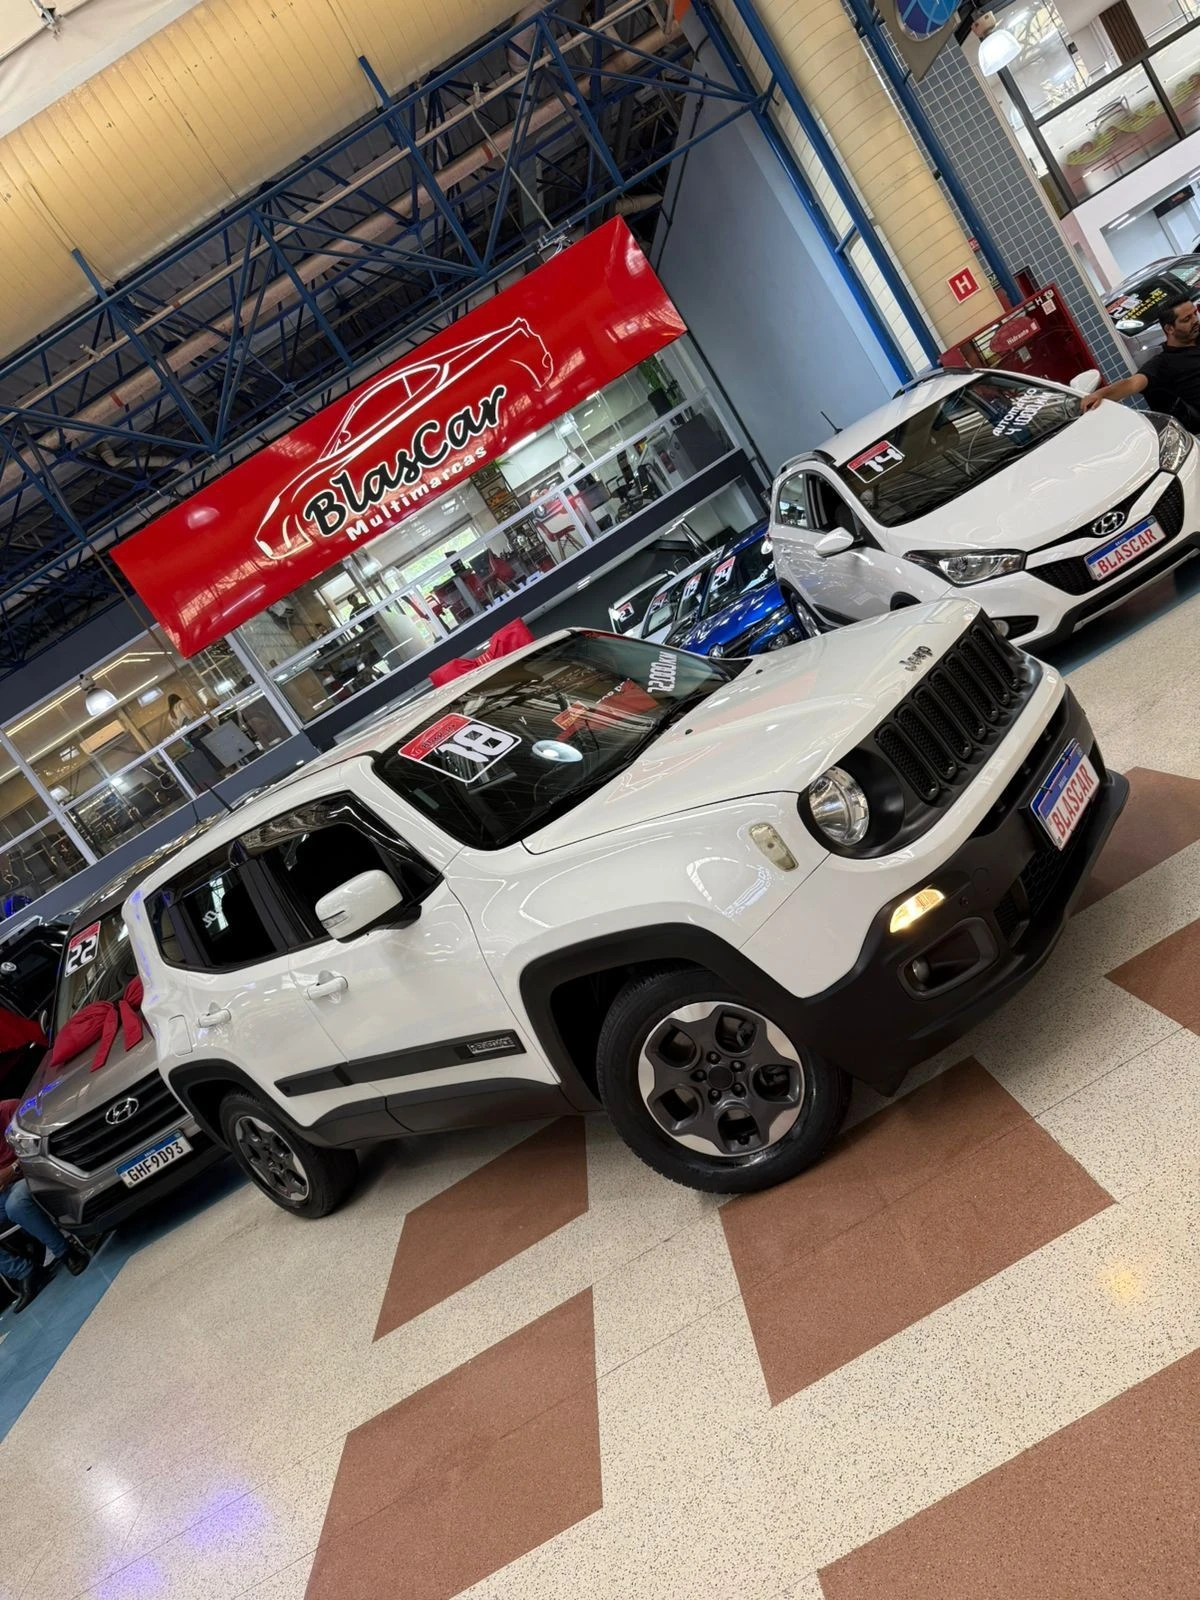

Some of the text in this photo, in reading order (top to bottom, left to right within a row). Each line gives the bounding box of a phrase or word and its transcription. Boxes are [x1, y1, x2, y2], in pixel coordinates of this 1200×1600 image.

[955, 275, 972, 294] H
[1035, 296, 1044, 306] H
[303, 385, 506, 536] BlasCar
[864, 448, 903, 472] 14
[346, 446, 487, 541] Multimarcas
[1097, 528, 1157, 574] BLASCAR
[898, 645, 933, 671] Jeep
[437, 723, 515, 763] 18
[1051, 763, 1094, 838] BLASCAR
[66, 935, 97, 973] 22
[127, 1141, 184, 1182] GHF9D93
